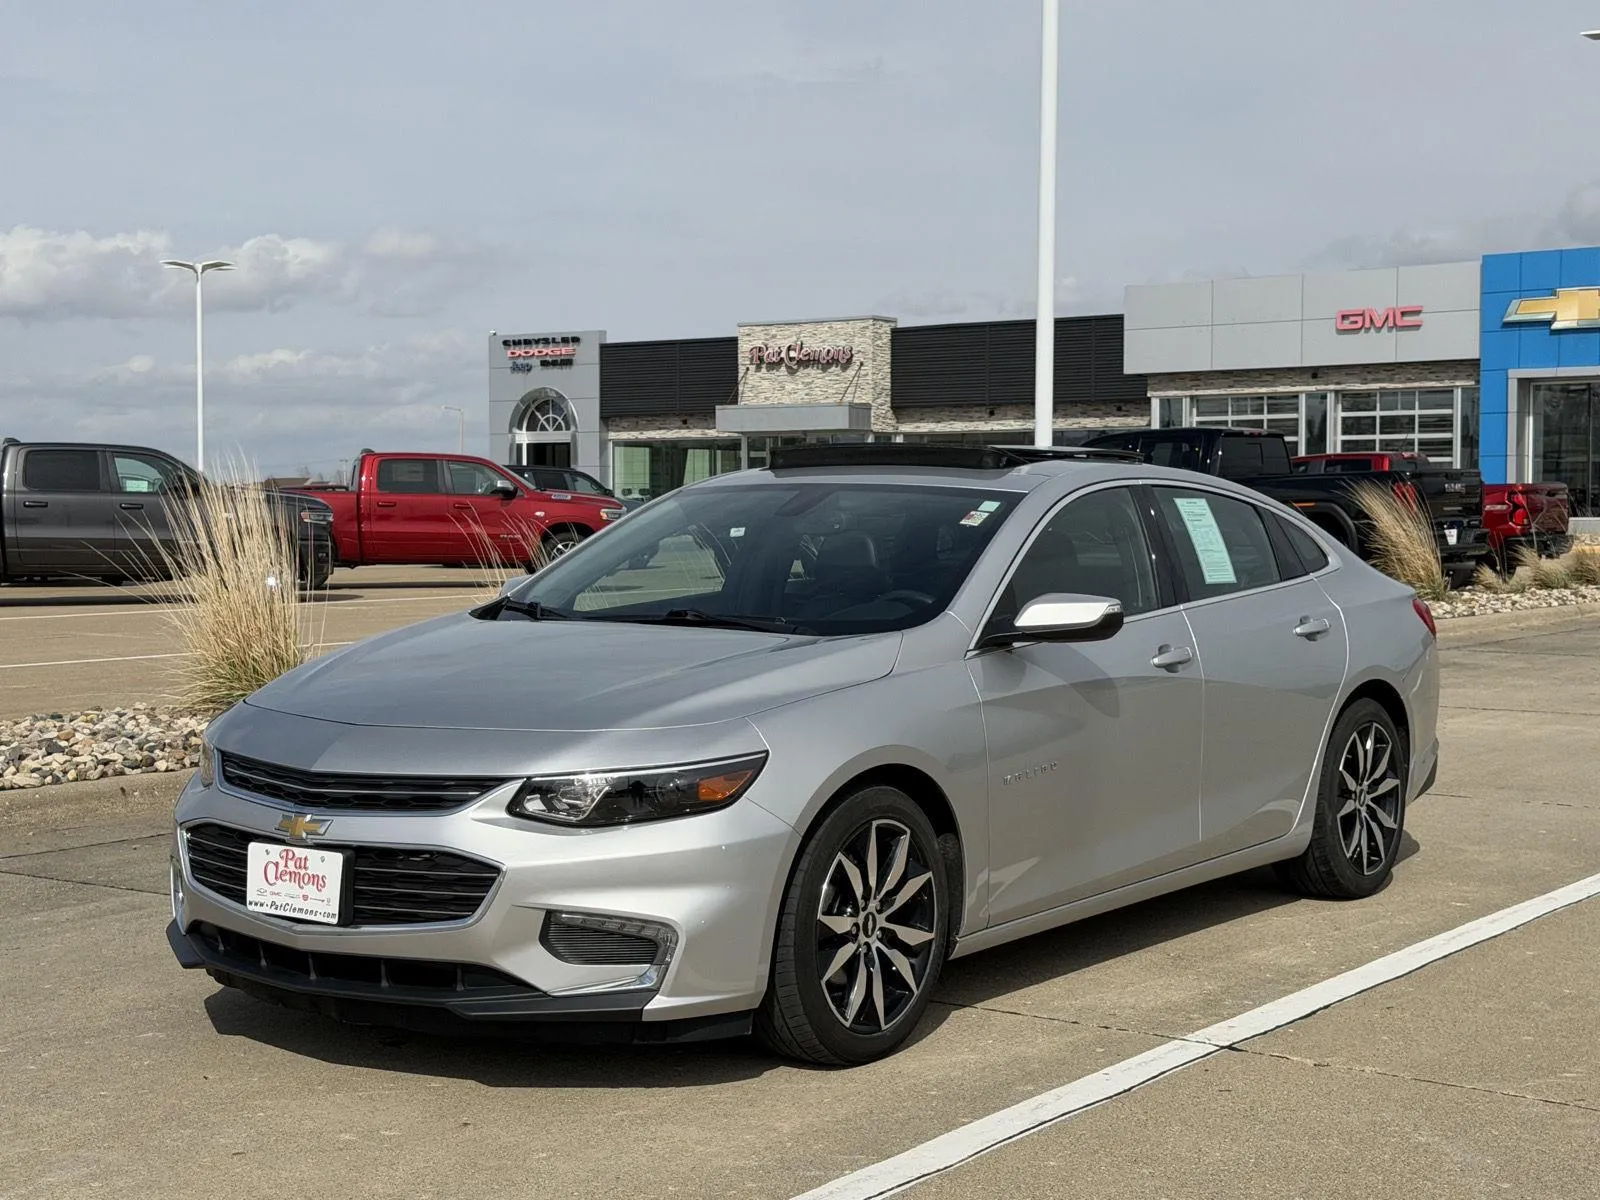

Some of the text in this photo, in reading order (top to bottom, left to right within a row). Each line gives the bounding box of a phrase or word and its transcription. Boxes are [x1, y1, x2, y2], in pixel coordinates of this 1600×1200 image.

[1336, 305, 1424, 330] GMC
[502, 336, 581, 346] CHRYSLER
[507, 348, 576, 358] DODGE
[749, 341, 854, 366] Pat Clemons
[279, 848, 309, 871] Pat
[264, 860, 328, 893] Clemons
